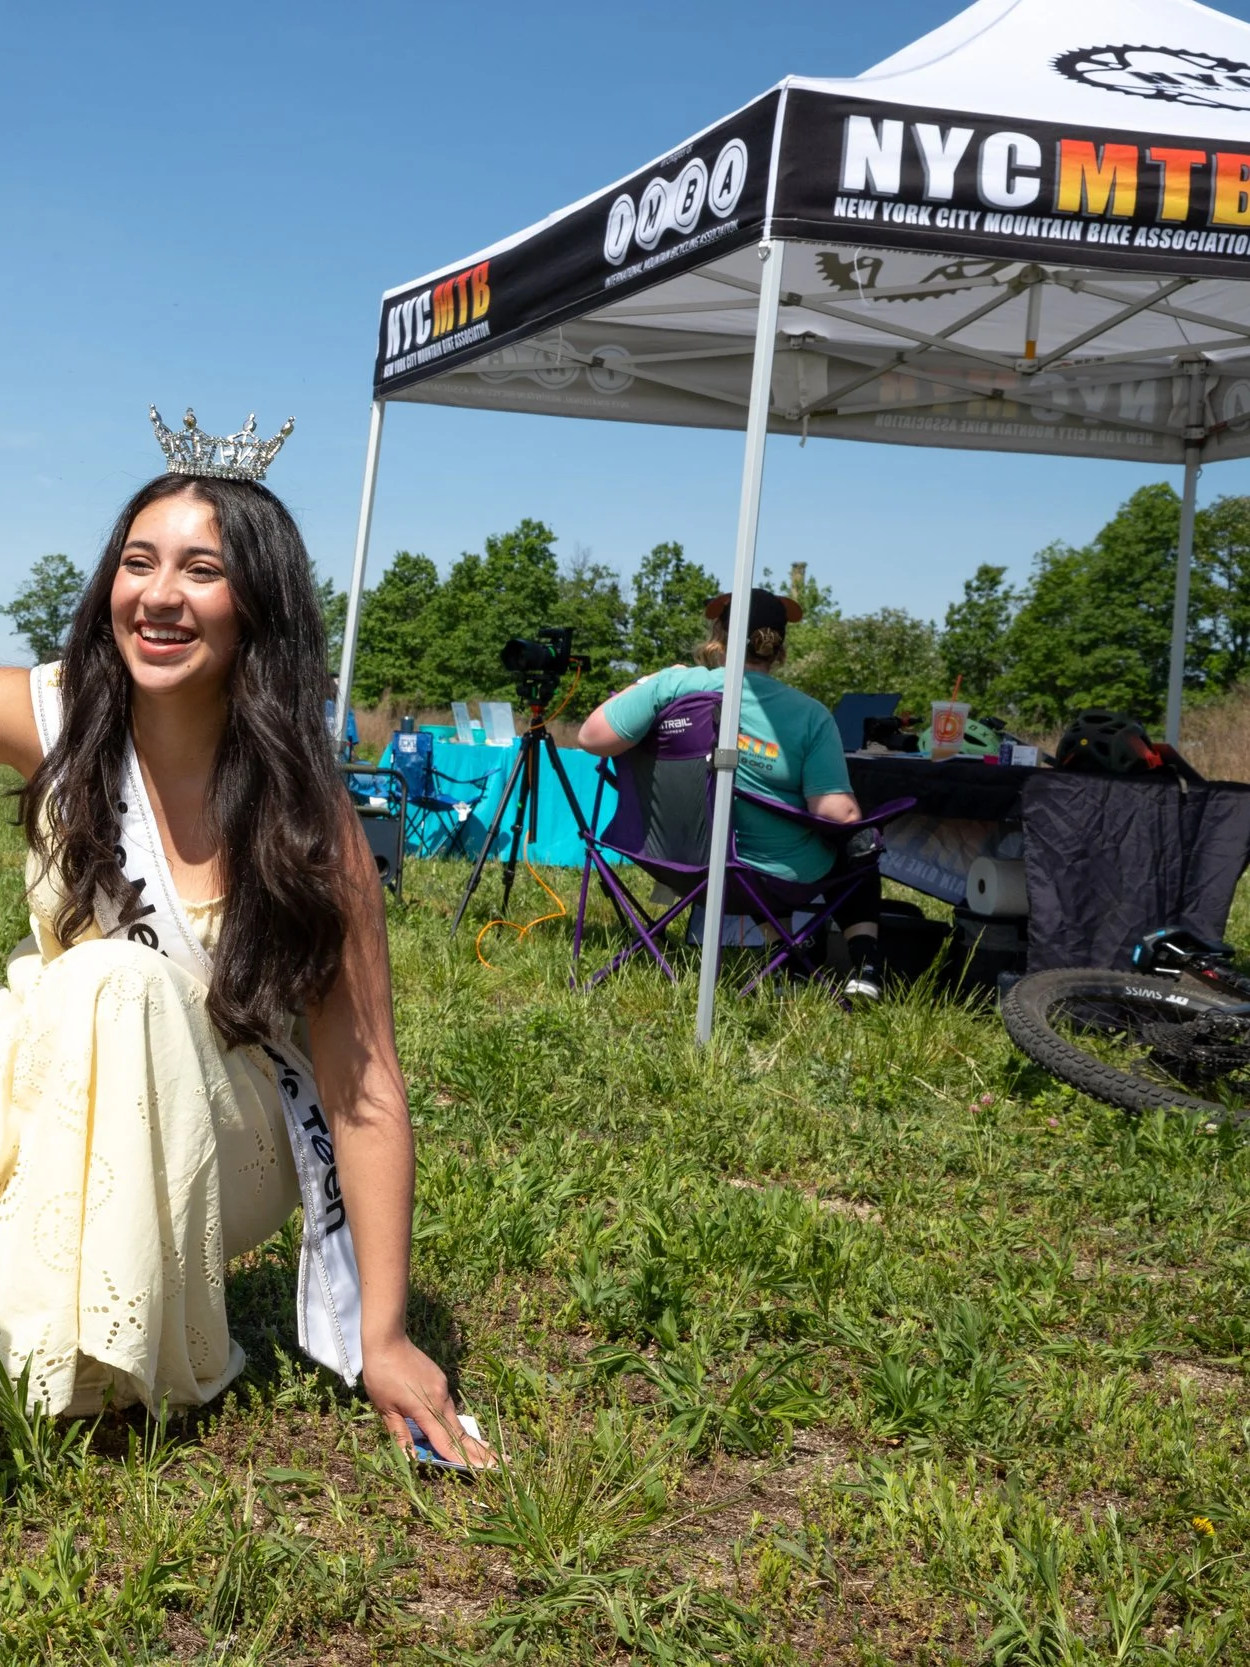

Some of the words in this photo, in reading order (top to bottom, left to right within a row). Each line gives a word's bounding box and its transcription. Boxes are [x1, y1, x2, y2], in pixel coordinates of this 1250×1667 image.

[834, 197, 878, 220] NEW
[882, 202, 931, 226] YORK
[935, 208, 981, 231] CITY
[984, 212, 1083, 241] MOUNTAIN
[1087, 222, 1132, 246] BIKE
[1133, 227, 1250, 255] ASSOCIATIO
[1125, 986, 1162, 1000] SWISS
[302, 1104, 345, 1235] Teen
